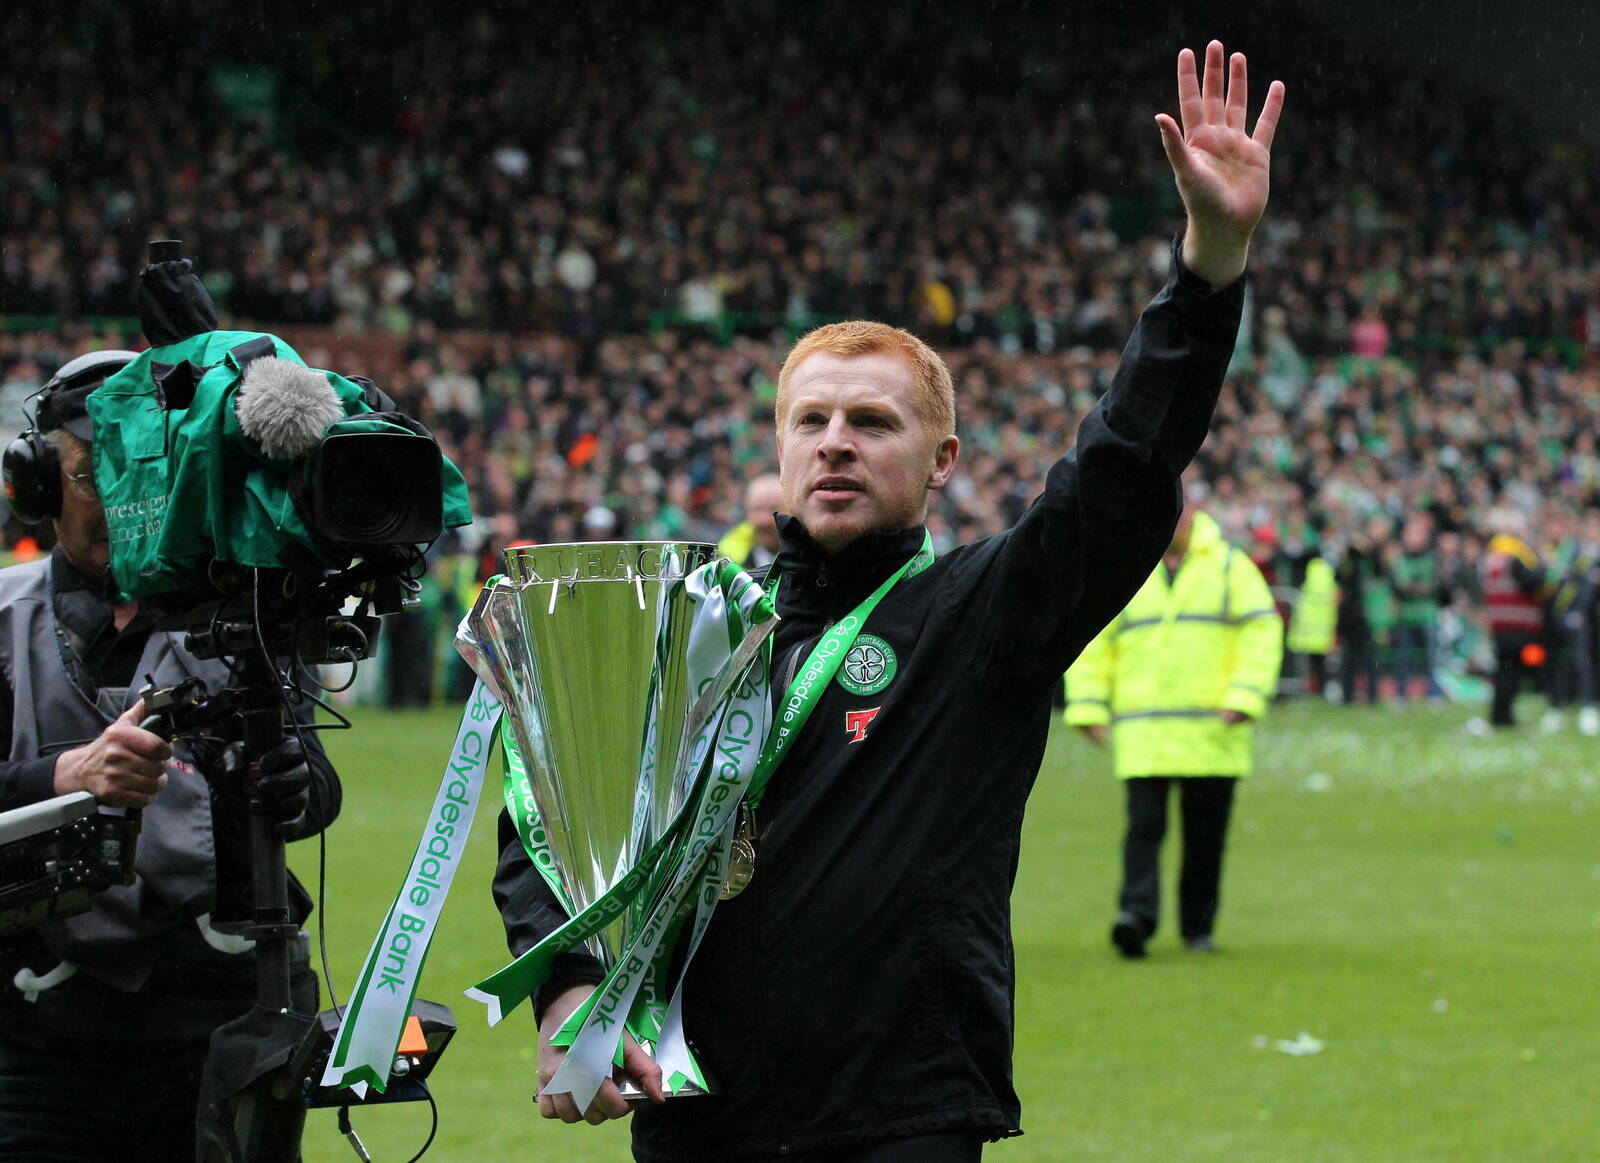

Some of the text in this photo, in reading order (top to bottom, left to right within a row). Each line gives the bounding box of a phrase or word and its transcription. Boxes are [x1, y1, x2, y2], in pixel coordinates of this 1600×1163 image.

[783, 638, 840, 723] Clydesdale
[857, 637, 895, 663] FOOTBALL CLUB
[409, 730, 482, 907] Clydesdale
[376, 913, 426, 994] Bank
[549, 895, 623, 951] Bank
[591, 957, 644, 1034] Bank
